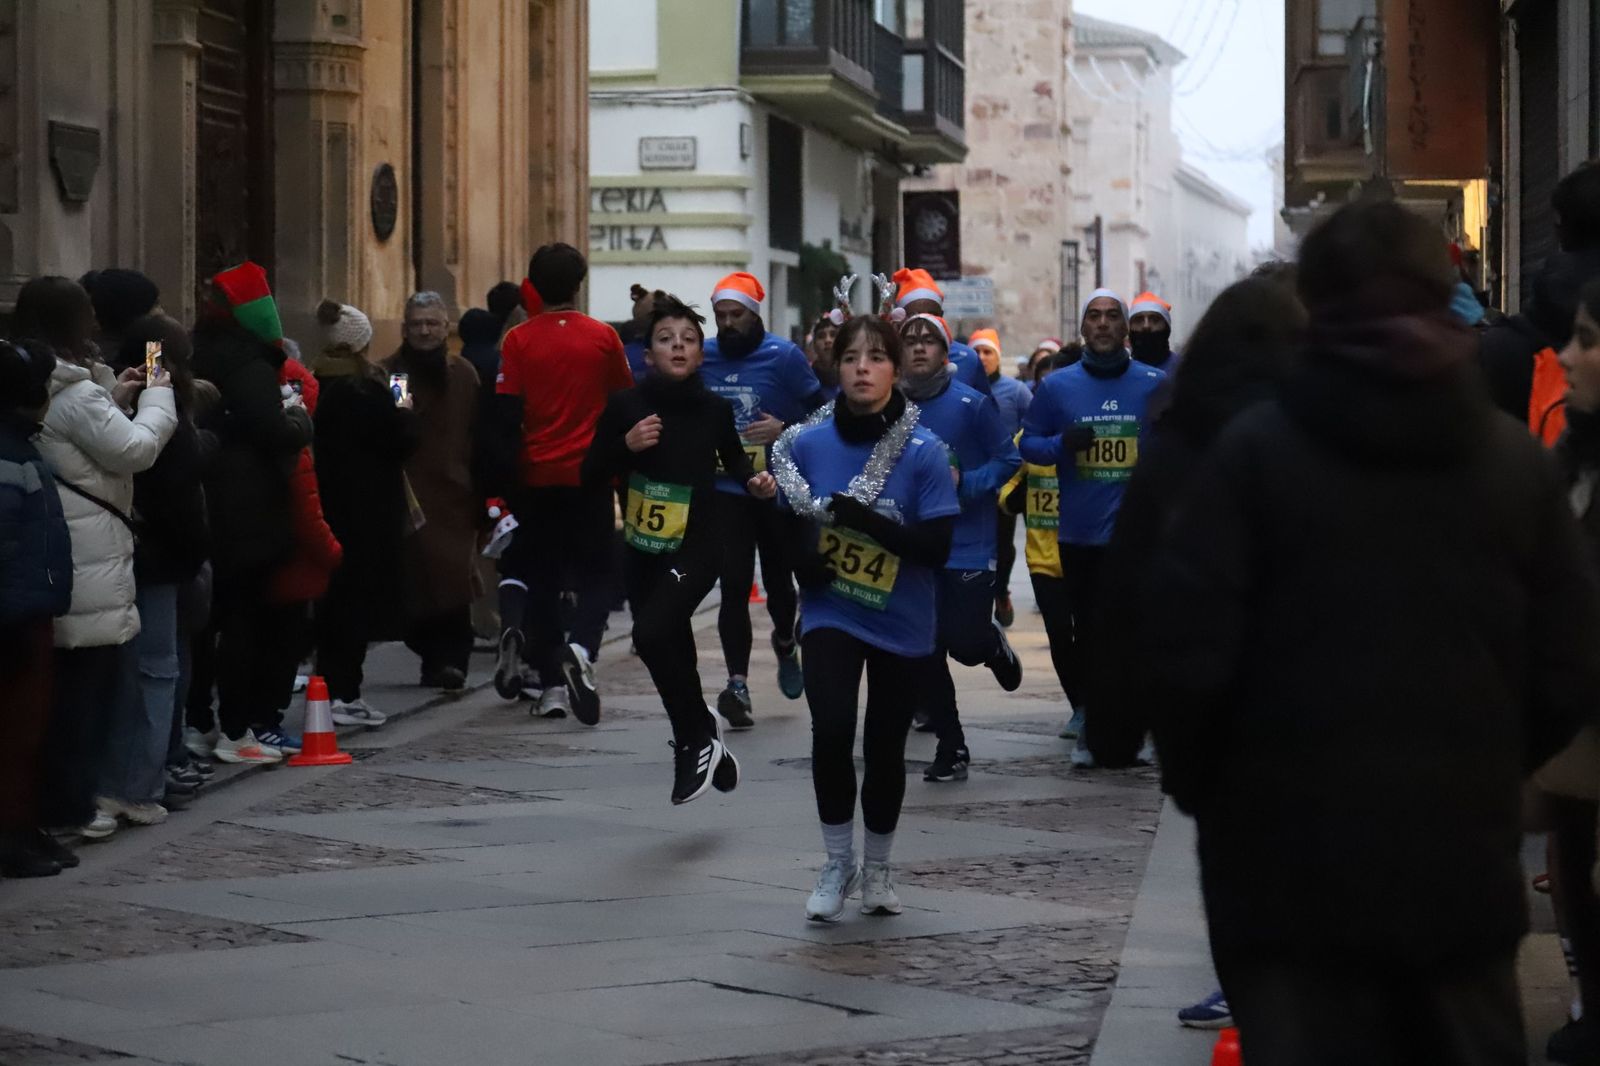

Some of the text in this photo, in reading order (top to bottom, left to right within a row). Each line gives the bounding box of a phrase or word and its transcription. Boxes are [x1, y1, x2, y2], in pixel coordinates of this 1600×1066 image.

[724, 373, 739, 383] 46
[1101, 399, 1118, 411] 46
[1032, 491, 1060, 512] 12
[636, 500, 666, 531] 45
[823, 534, 886, 582] 254
[852, 587, 882, 603] RURAL
